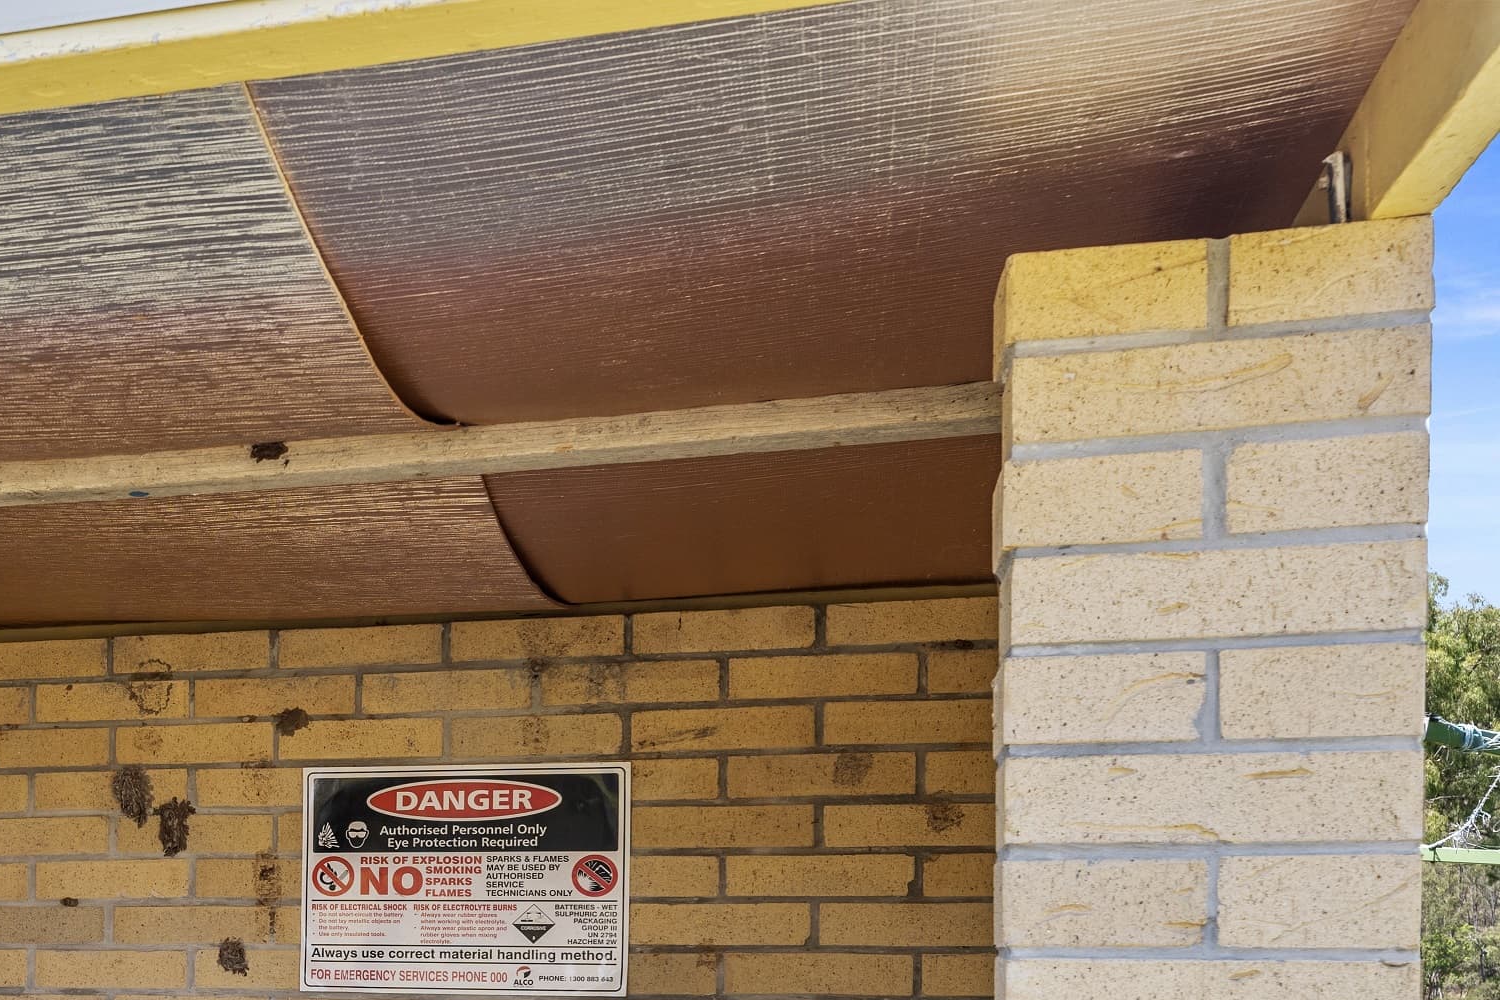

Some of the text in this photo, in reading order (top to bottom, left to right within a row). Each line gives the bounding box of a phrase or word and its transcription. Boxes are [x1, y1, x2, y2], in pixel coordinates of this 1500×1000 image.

[396, 789, 532, 811] DANGER
[380, 824, 547, 836] Authorised Personnel Only
[387, 836, 538, 850] Eye Protection Required
[360, 856, 482, 864] RISK OF EXPLOSION
[425, 866, 482, 874] SMOKING
[360, 866, 423, 896] NO
[425, 877, 472, 885] SPARKS
[425, 889, 472, 897] FLAMES
[311, 947, 617, 962] Always use correct material handling method.
[311, 968, 507, 982] FOR EMERGENCY SERVICES PHONE 000
